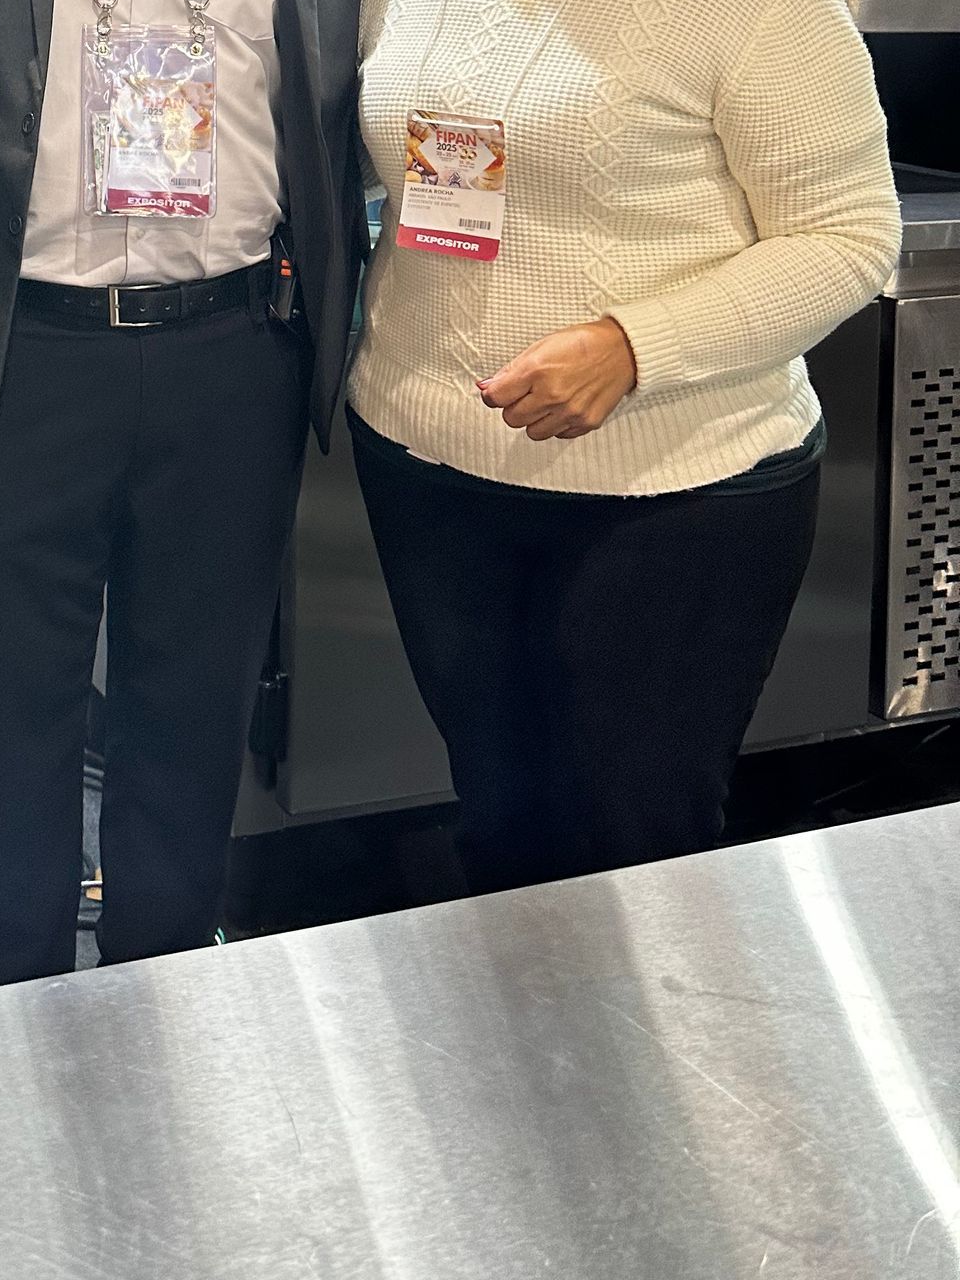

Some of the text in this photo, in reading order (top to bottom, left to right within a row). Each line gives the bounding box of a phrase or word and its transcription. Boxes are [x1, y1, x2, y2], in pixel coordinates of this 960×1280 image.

[436, 129, 478, 147] FIPAN
[436, 142, 458, 152] 2025
[416, 233, 480, 252] EXPOSITOR
